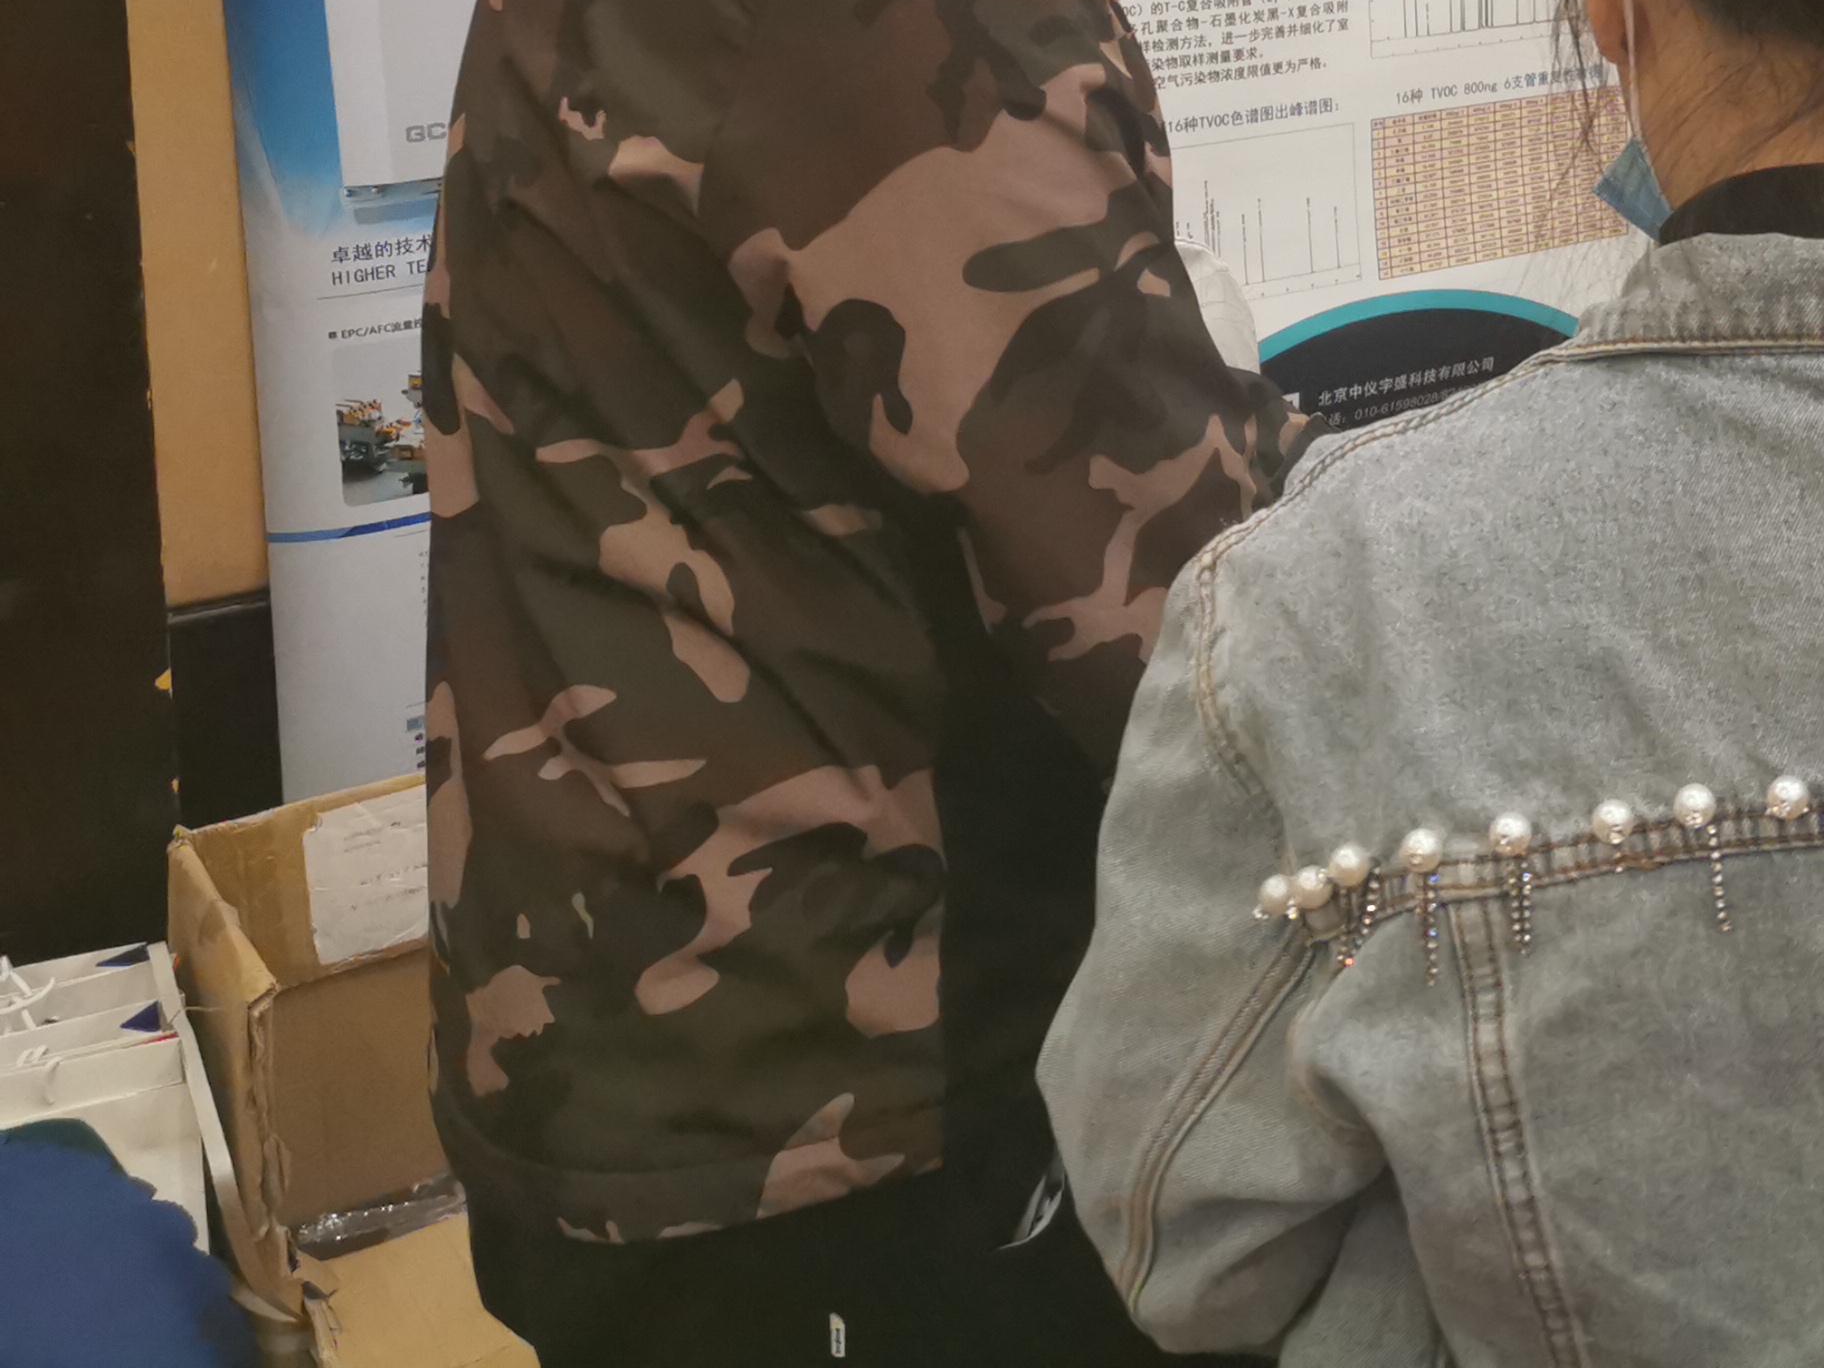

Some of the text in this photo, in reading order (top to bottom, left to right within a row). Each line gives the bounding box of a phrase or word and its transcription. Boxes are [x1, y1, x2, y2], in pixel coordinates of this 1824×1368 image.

[1146, 46, 1264, 73] 染物取样测量要求。
[1396, 88, 1424, 105] 16种
[1431, 84, 1458, 100] TVOC
[1464, 80, 1498, 95] 800ng
[406, 122, 447, 143] GC
[331, 234, 432, 264] 卓越的技术
[331, 258, 430, 286] HIGHER TE
[1318, 356, 1495, 407] 北京中仪宇盛科技有限公司
